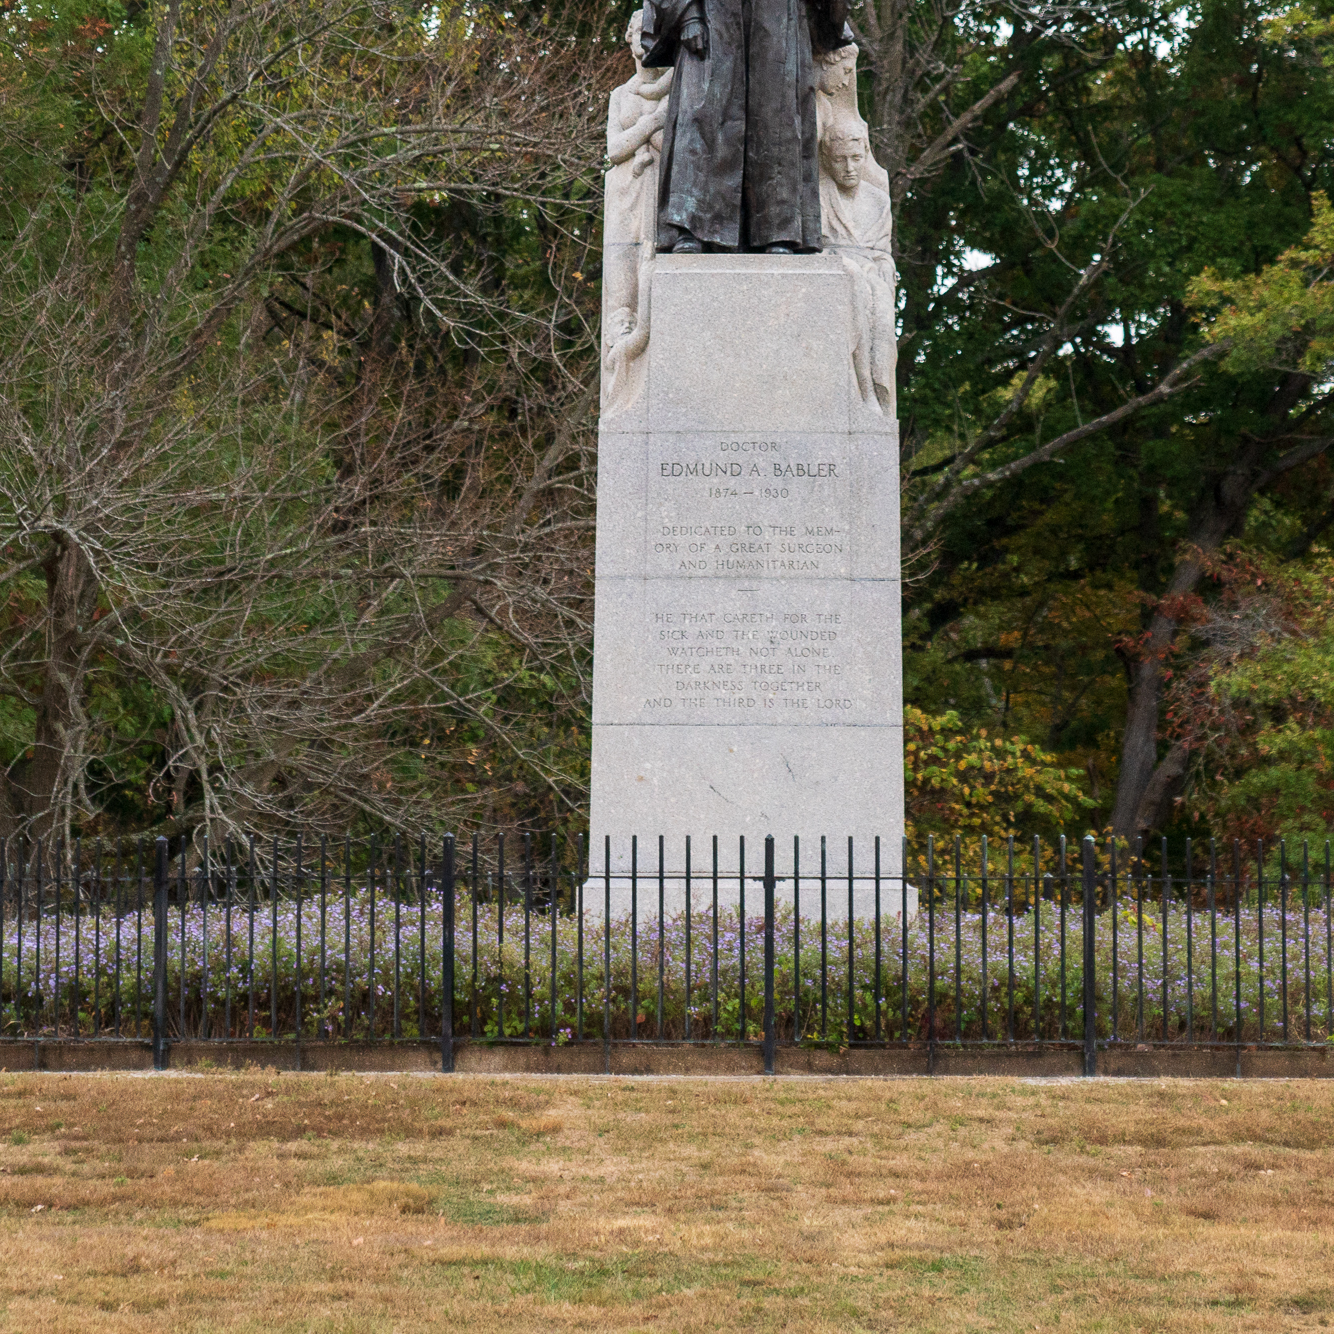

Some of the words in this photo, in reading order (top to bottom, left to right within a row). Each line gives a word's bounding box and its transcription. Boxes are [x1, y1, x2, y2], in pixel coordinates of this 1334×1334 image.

[721, 442, 779, 452] DOCTOR
[661, 463, 742, 477] EDMUND
[749, 463, 767, 477] A.
[774, 463, 839, 477] BABLER
[709, 488, 738, 498] 1874
[760, 488, 789, 499] 1930
[662, 526, 736, 536] DEDICATED
[746, 526, 763, 536] TO
[771, 526, 796, 536] THE
[655, 543, 680, 553] ORY
[689, 543, 706, 553] OF
[714, 543, 722, 553] A
[730, 543, 772, 553] GREAT
[780, 543, 843, 553] SURGEON
[679, 560, 707, 570] AND
[716, 560, 819, 570] HUMANITARIAN
[681, 613, 715, 624] THAT
[724, 613, 774, 624] CARETH
[784, 614, 807, 624] FOR
[817, 614, 842, 624] THE
[659, 630, 688, 641] SICK
[697, 630, 725, 640] AND
[733, 630, 758, 640] THE
[767, 631, 837, 641] WOUNDED
[667, 647, 740, 657] WATCHETH
[750, 647, 778, 657] NOT
[657, 664, 700, 674] THERE
[708, 664, 733, 674] ARE
[741, 664, 784, 675] THREE
[793, 664, 806, 674] IN
[816, 664, 841, 675] THE
[676, 681, 743, 691] DARKNESS
[751, 681, 823, 692] TOGETHER
[644, 699, 672, 708] AND
[681, 698, 705, 708] THE
[714, 698, 755, 708] THIRD
[764, 698, 775, 709] IS
[783, 698, 808, 709] THE
